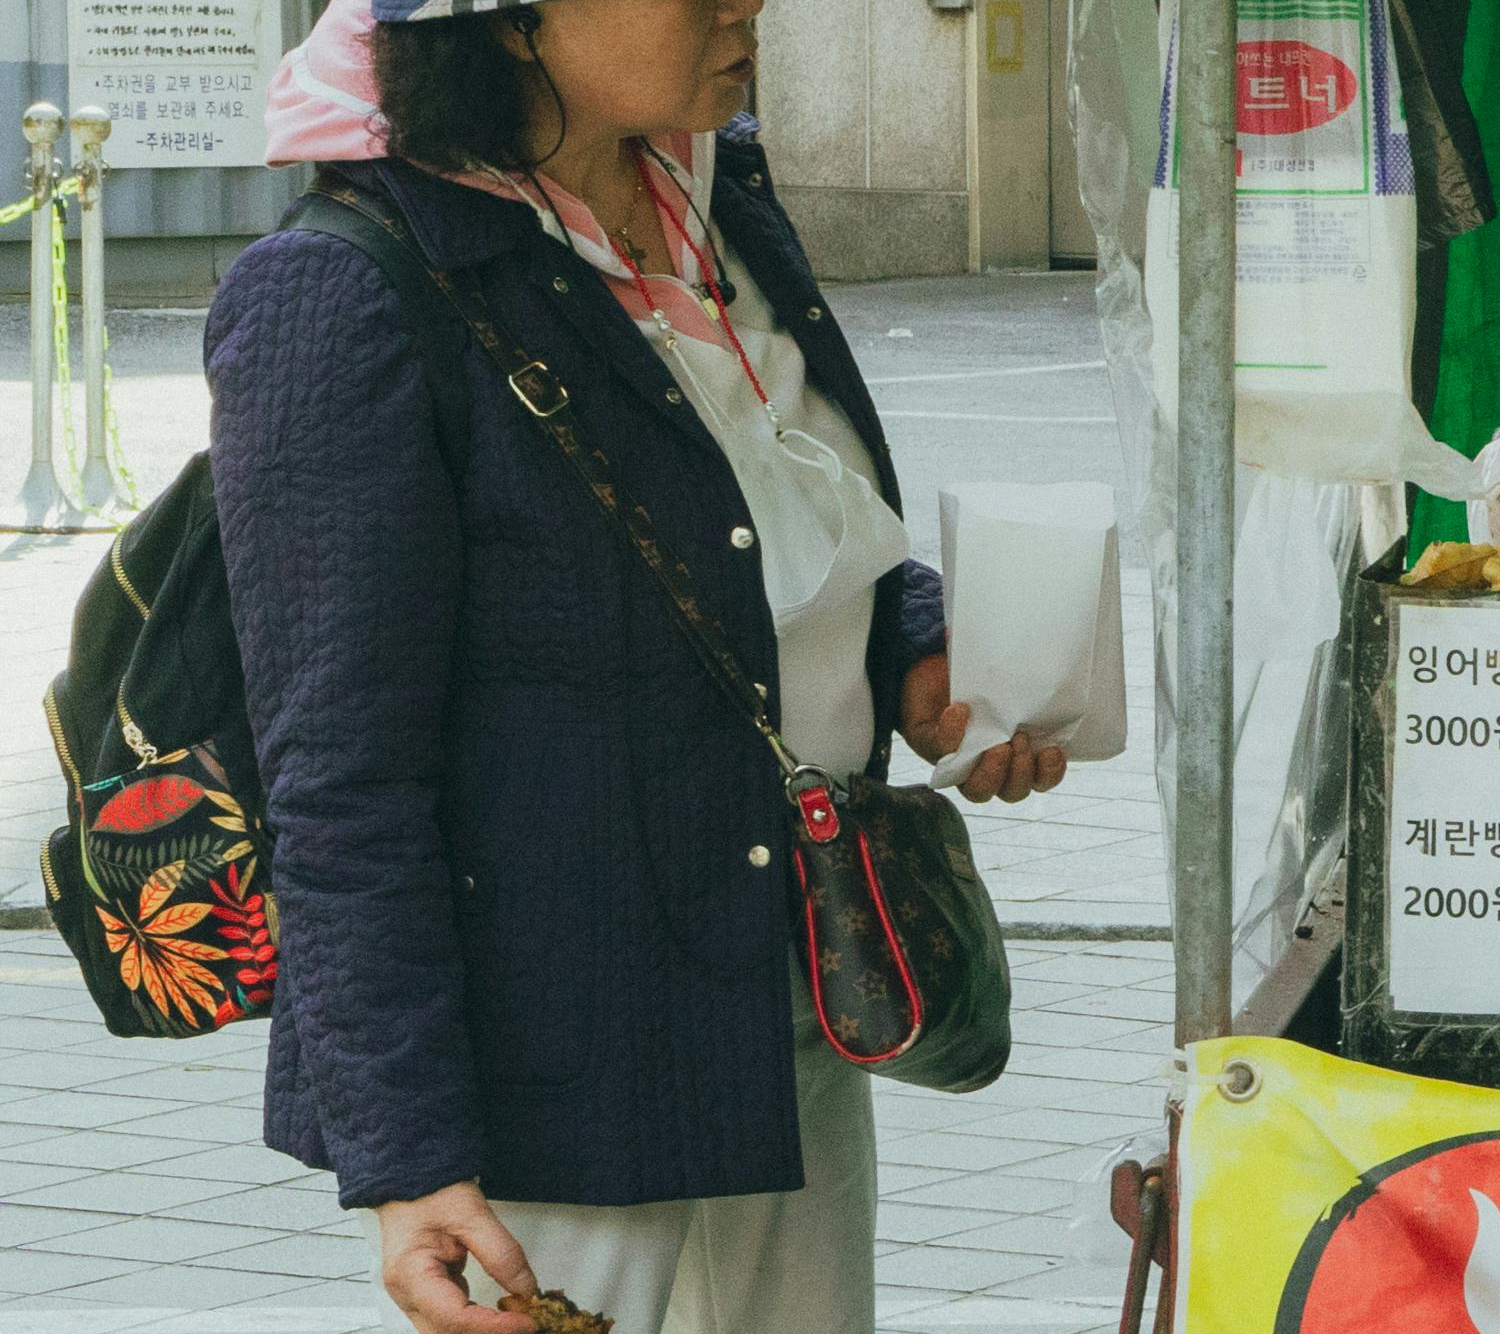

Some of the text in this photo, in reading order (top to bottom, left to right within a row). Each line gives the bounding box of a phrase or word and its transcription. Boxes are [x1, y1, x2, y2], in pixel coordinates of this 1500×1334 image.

[103, 75, 253, 93] 주차권을 교부 받으시고
[108, 101, 249, 120] 열쇠를 보관해 주세요.
